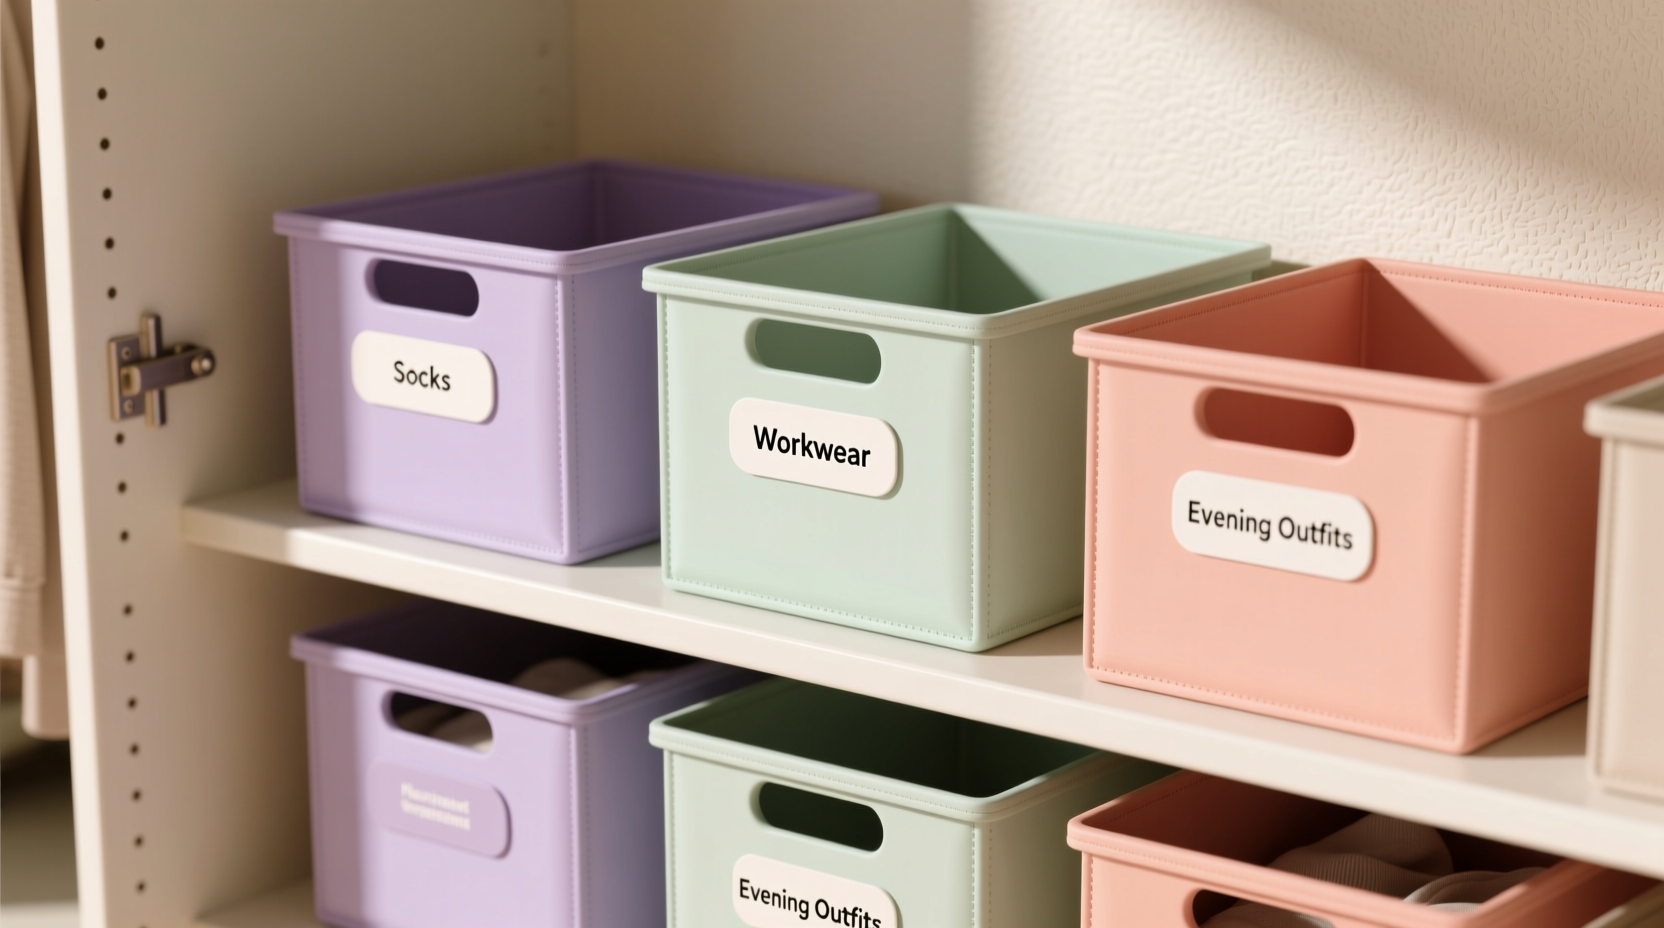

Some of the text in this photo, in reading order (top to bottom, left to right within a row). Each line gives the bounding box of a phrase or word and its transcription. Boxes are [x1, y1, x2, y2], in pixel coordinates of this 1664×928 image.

[393, 359, 452, 393] Socks
[753, 424, 872, 469] Workwear
[1187, 500, 1354, 550] Evening Outfits
[739, 877, 882, 928] Evening Outfits
